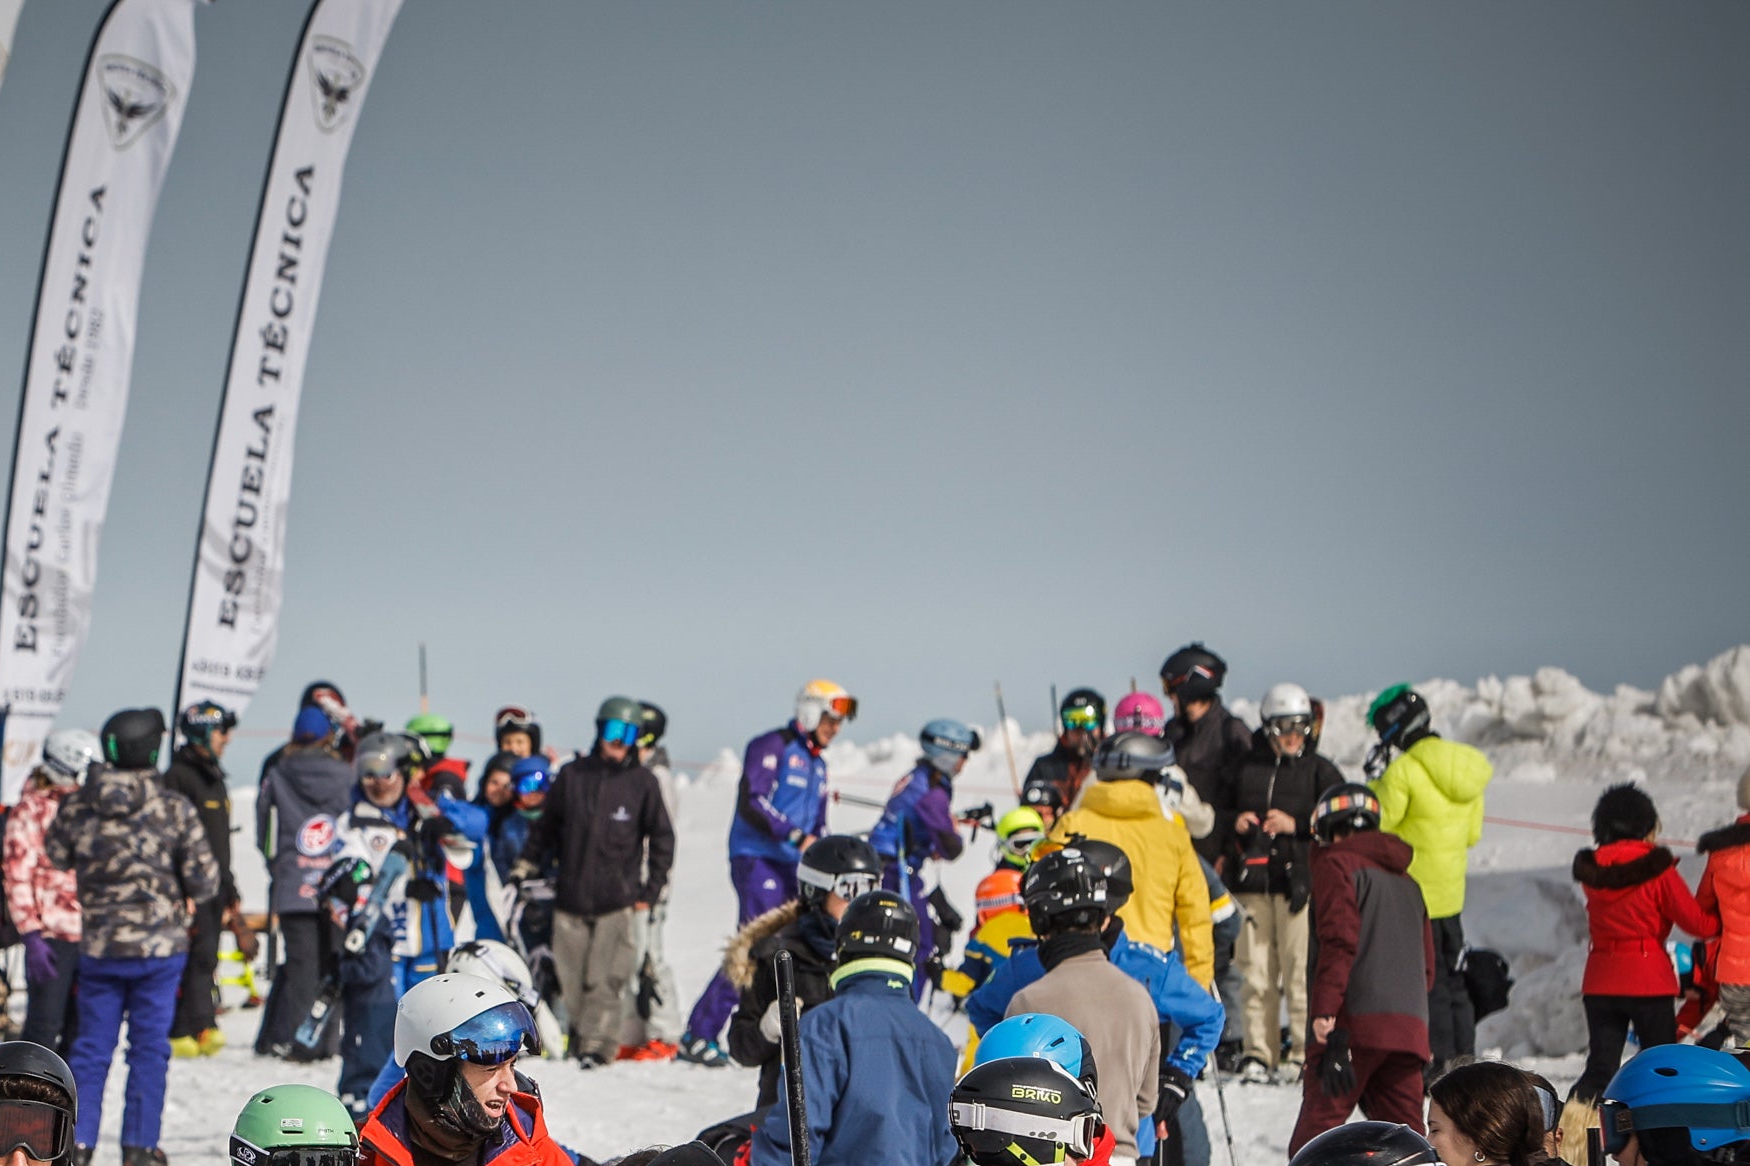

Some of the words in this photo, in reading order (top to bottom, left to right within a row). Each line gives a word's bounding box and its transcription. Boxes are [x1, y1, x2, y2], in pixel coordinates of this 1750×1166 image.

[14, 426, 60, 656] ESCUELA
[50, 184, 108, 411] TÉCNICA
[218, 404, 275, 631] ESCUELA
[258, 164, 315, 387] TÉCNICA
